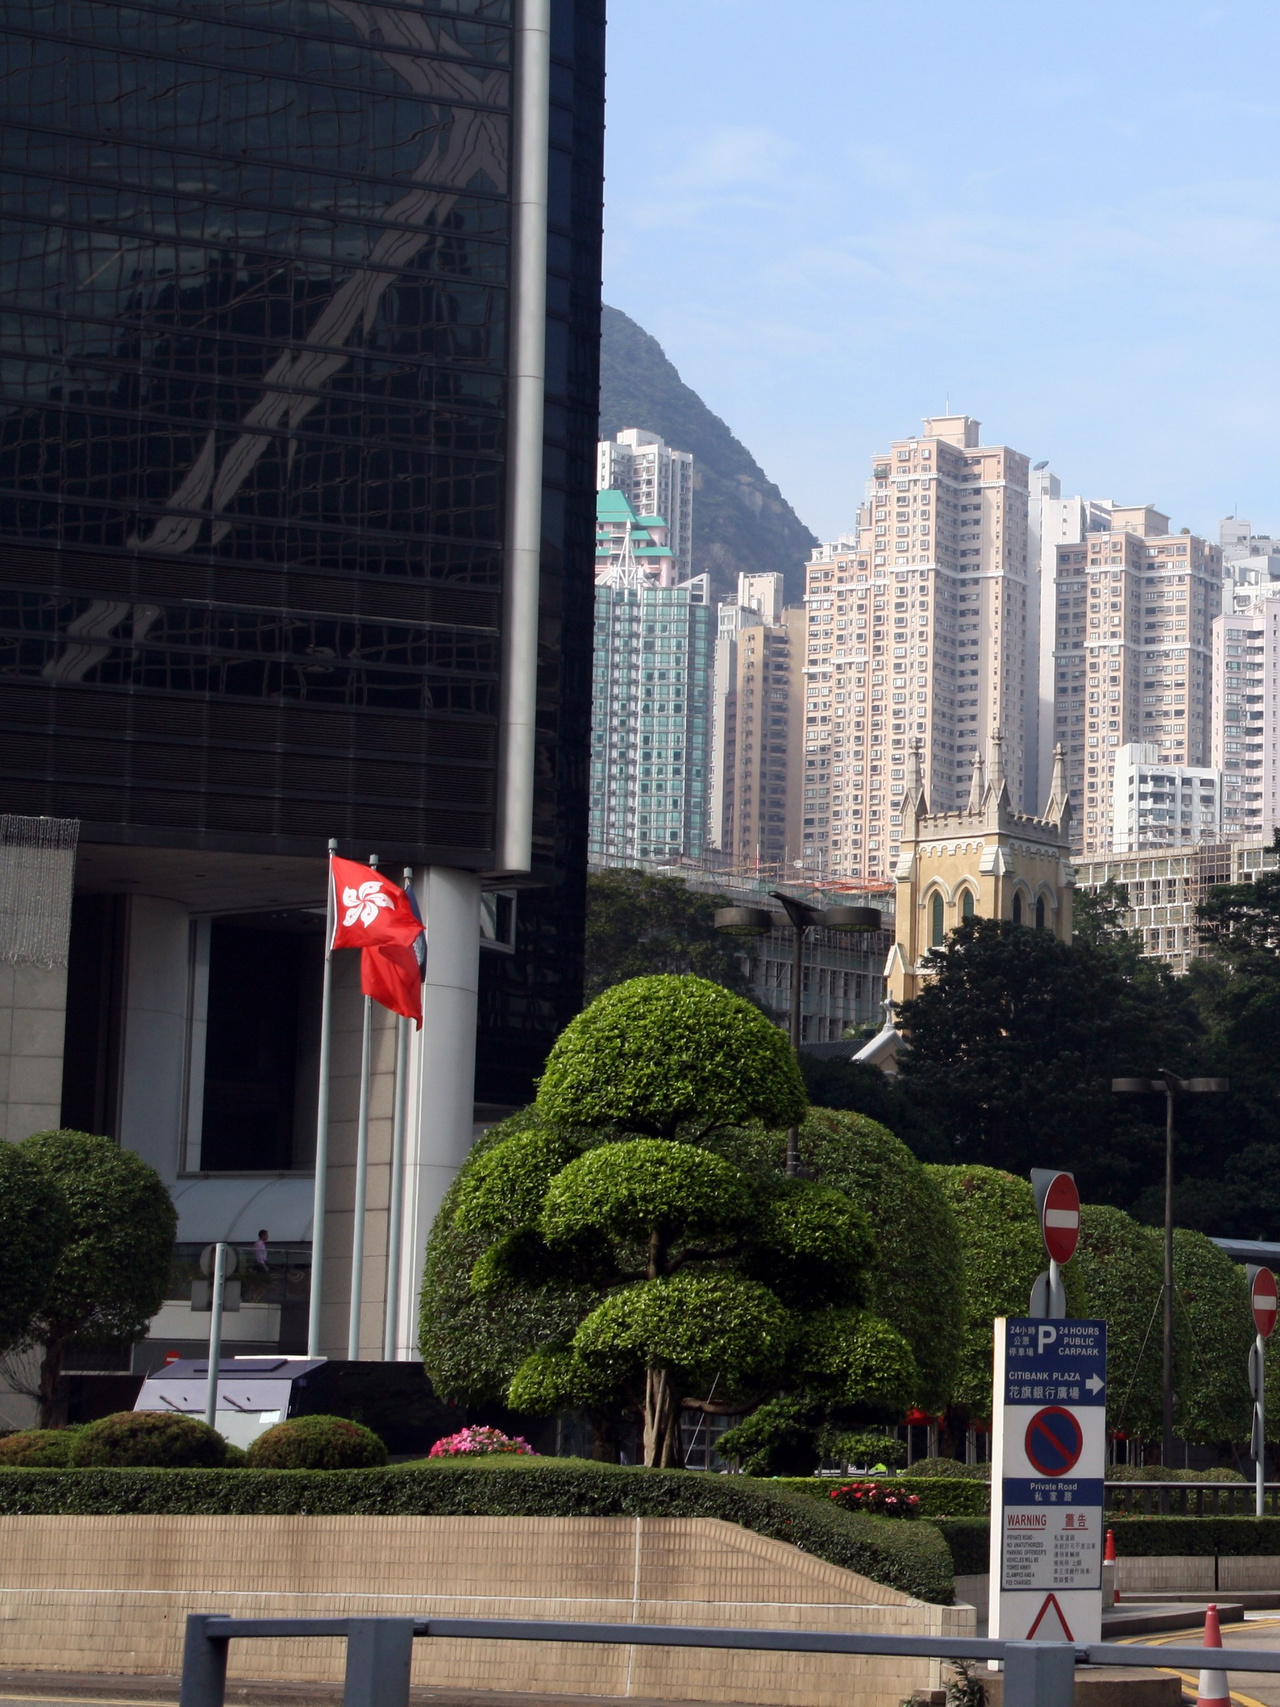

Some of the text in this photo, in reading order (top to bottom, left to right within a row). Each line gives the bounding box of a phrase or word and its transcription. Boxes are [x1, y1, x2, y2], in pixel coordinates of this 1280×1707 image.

[1010, 1326, 1035, 1335] 24小時
[1070, 1327, 1099, 1335] HOURS
[1037, 1325, 1057, 1354] P
[1063, 1337, 1094, 1345] PUBLIC
[1058, 1347, 1099, 1355] CARPARK
[1008, 1371, 1081, 1380] CITIBANK PLAZA
[1009, 1385, 1080, 1400] 花旗銀行廣場
[1030, 1482, 1078, 1491] Private Road
[1034, 1491, 1073, 1502] 私家路
[1007, 1514, 1047, 1527] WARNING
[1065, 1513, 1087, 1528] 警告
